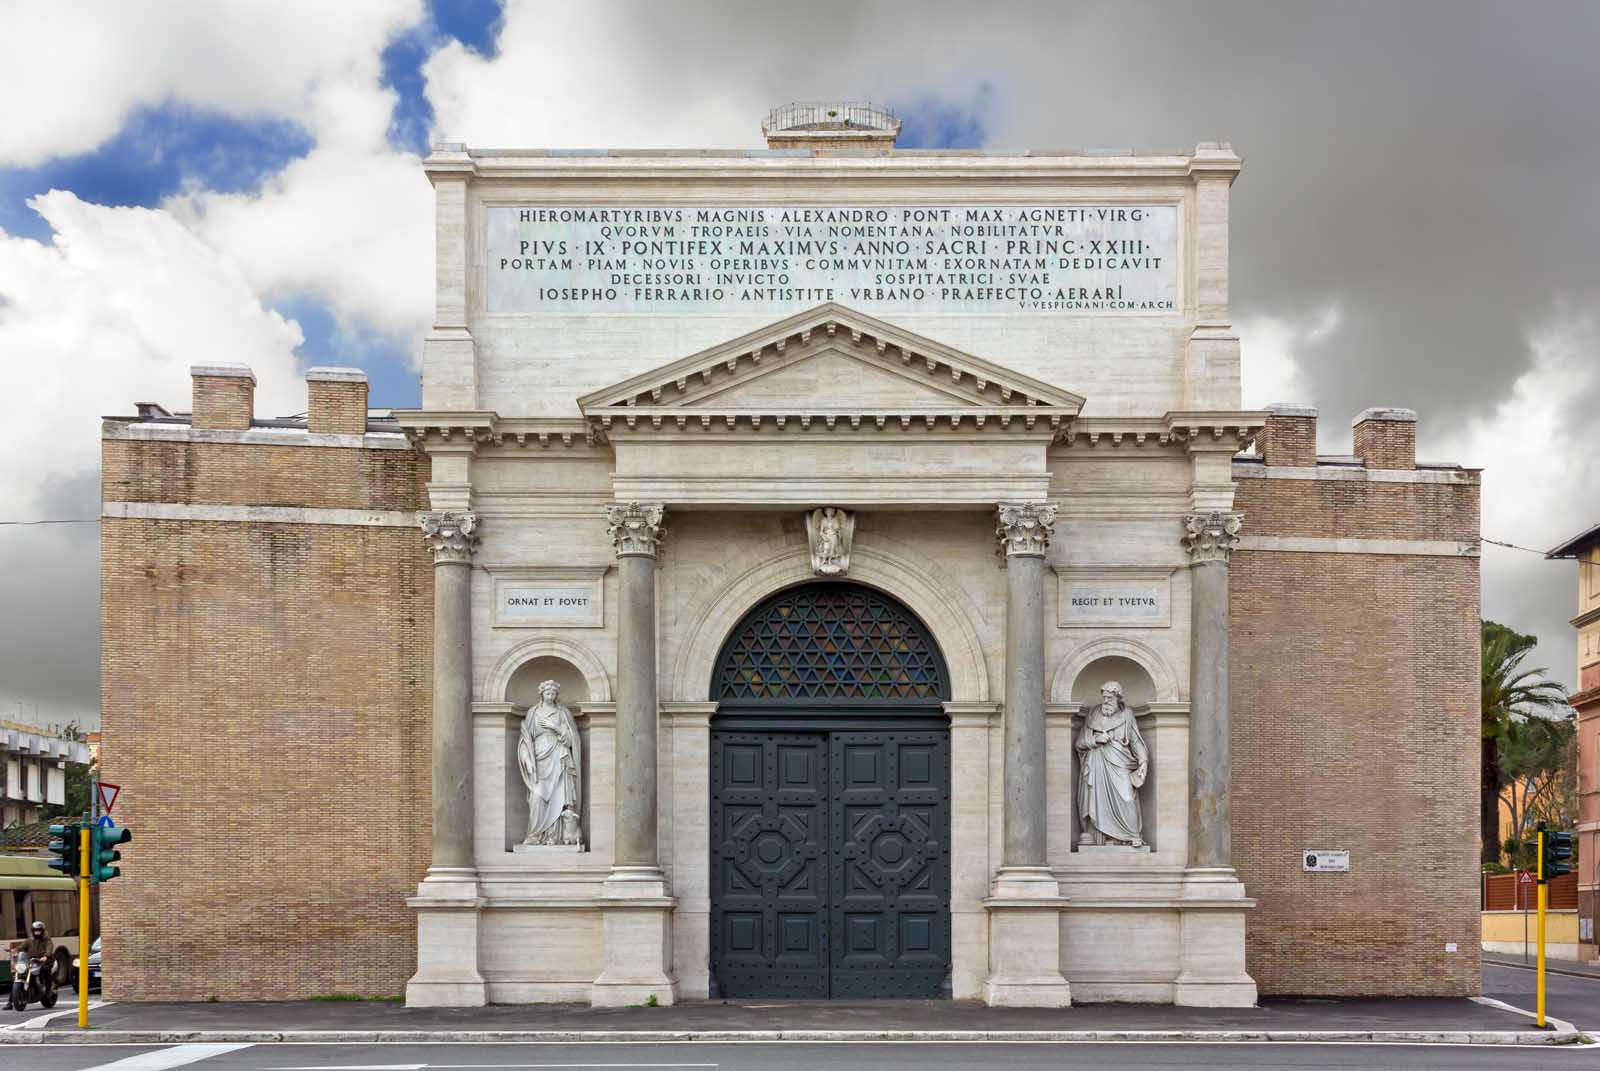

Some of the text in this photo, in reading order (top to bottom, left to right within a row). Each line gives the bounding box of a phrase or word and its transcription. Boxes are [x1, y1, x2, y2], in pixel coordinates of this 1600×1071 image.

[519, 209, 1143, 223] HIEROMARTYRIBVS MAGNIS ALEXANDRO PONT MAX AGNETI VIRG
[600, 225, 1065, 240] QVORVM TROPAEIS VIA NOMENTANA NOBILITATVR
[519, 240, 1144, 256] PIVS IX PONTIFEX MAXIMVS ANNO SACRI PRINC XXIII
[500, 257, 1162, 271] PORTAM PIAM NOVIS OPERIBVS COMMVNITAM EXORNATAM DEDICAVIT
[610, 273, 1052, 285] DECESSORI INVICTO SOSPITATRICI SVAE
[539, 287, 618, 301] IOSEPHO
[633, 287, 725, 301] FERRARIO
[739, 287, 836, 301] ANTISTITE
[850, 287, 925, 301] VRBANO
[940, 287, 1043, 301] PRAEFECTO
[507, 598, 588, 606] ORNAT ET FOVET
[1071, 598, 1155, 606] REGIT ET TVETVR
